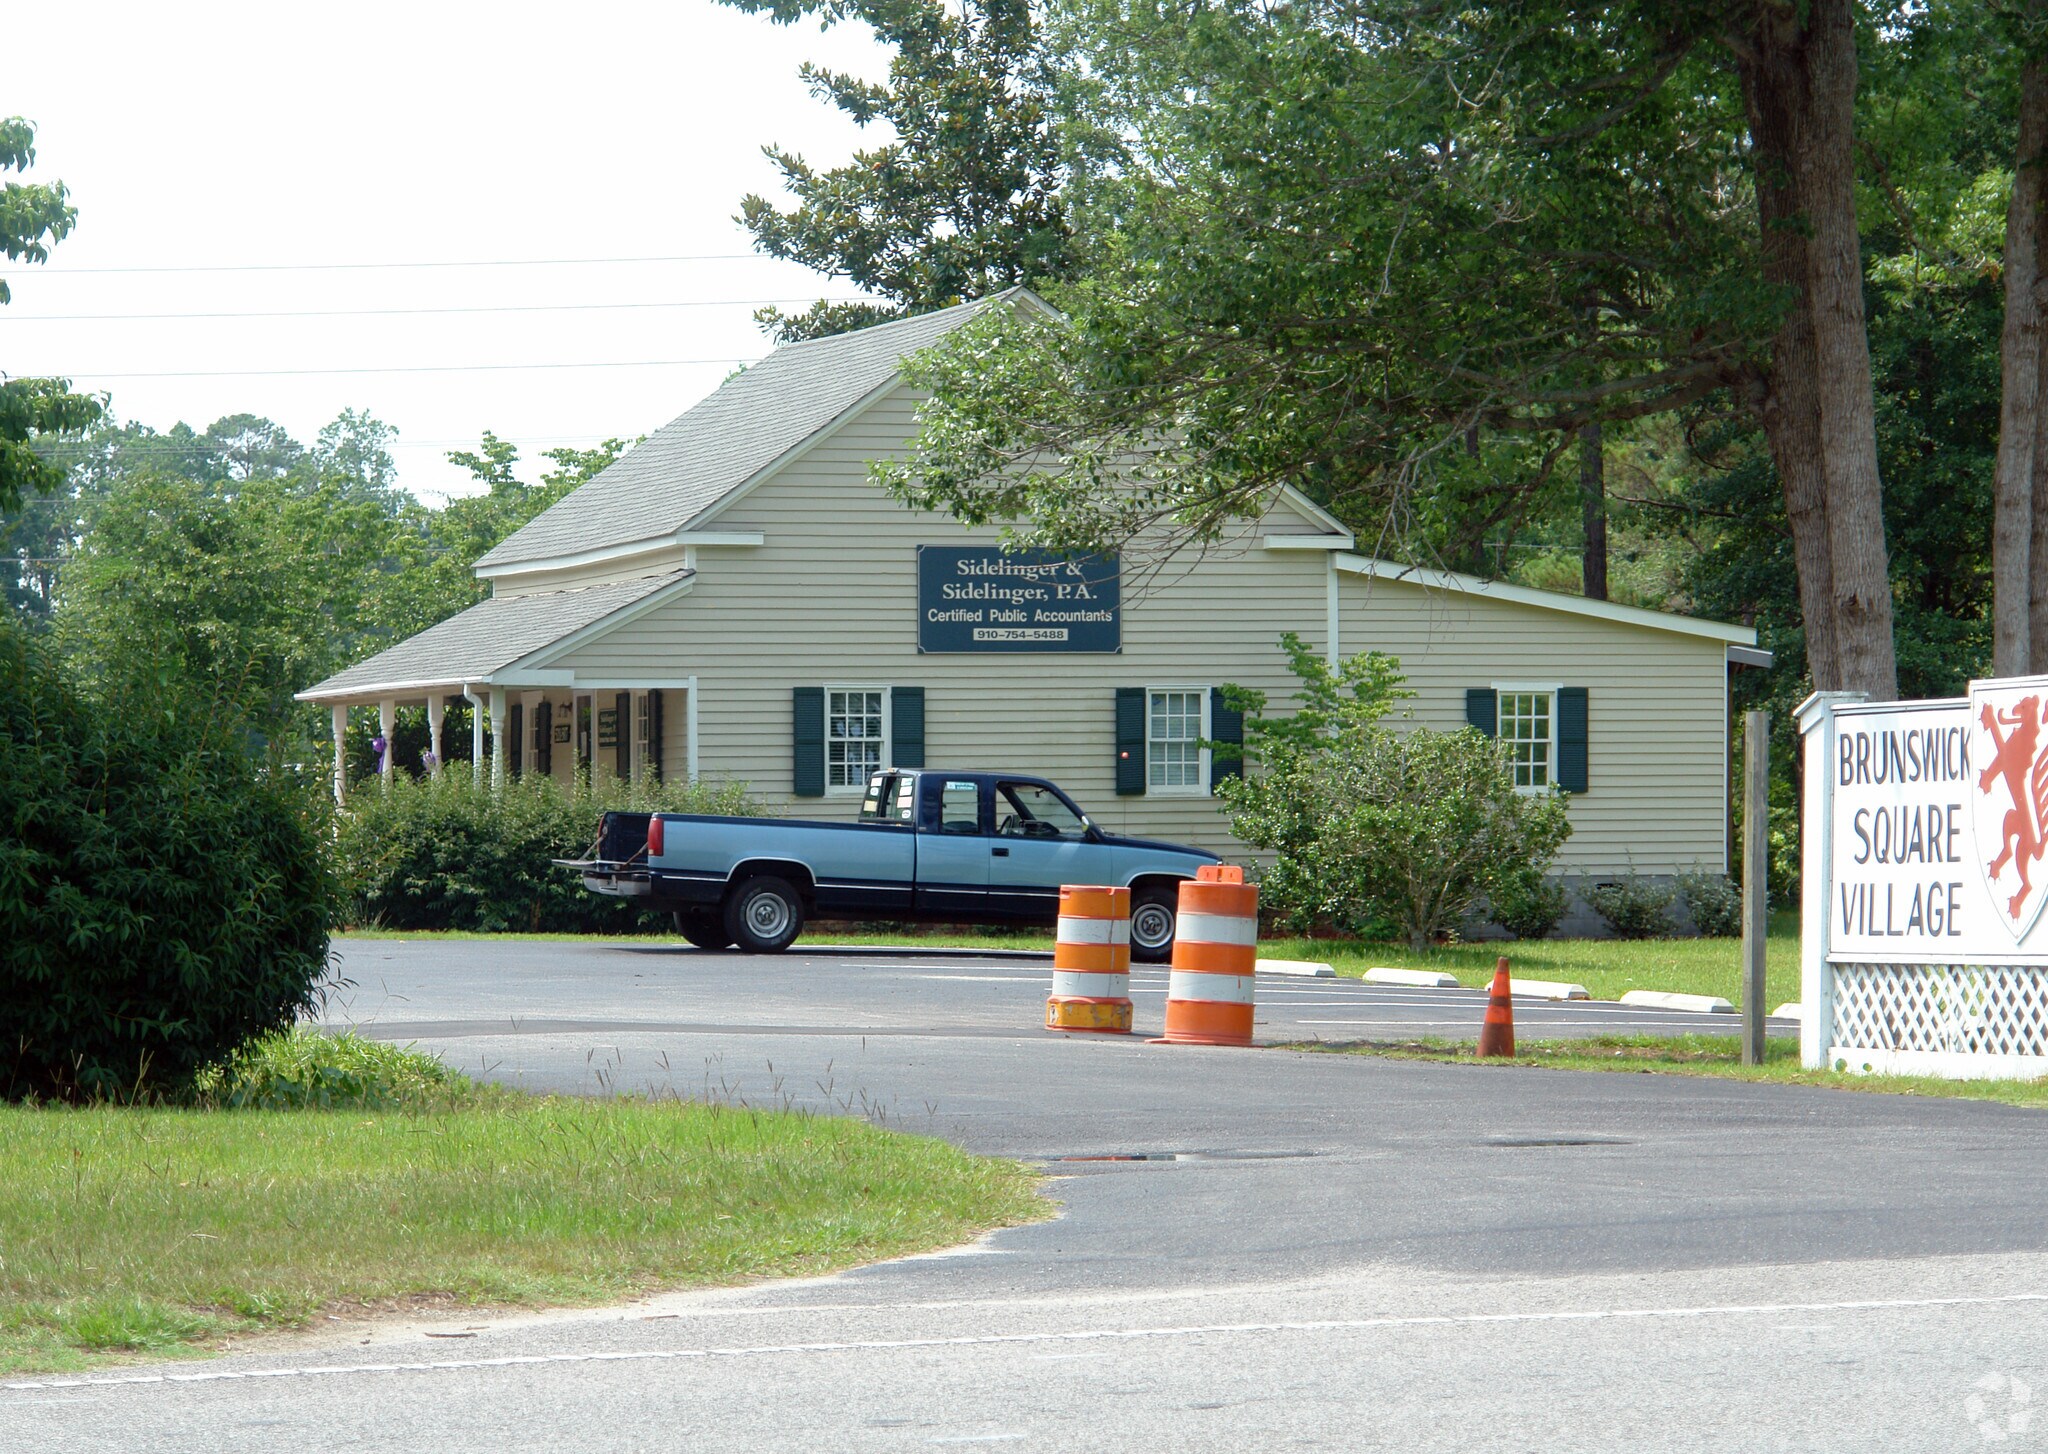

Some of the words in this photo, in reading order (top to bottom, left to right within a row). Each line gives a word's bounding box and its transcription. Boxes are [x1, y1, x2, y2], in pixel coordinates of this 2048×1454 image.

[957, 559, 1059, 580] Sidelinger
[1066, 563, 1082, 576] &
[942, 583, 1049, 605] Sidelinger,
[927, 608, 982, 622] Certified
[990, 609, 1027, 622] Public
[1034, 609, 1112, 622] Accountants
[977, 630, 1064, 639] 910-754-5488
[1840, 726, 1970, 786] BRUNSWICK
[1854, 804, 1961, 865] SQUARE
[1841, 881, 1963, 937] VILLAGE
